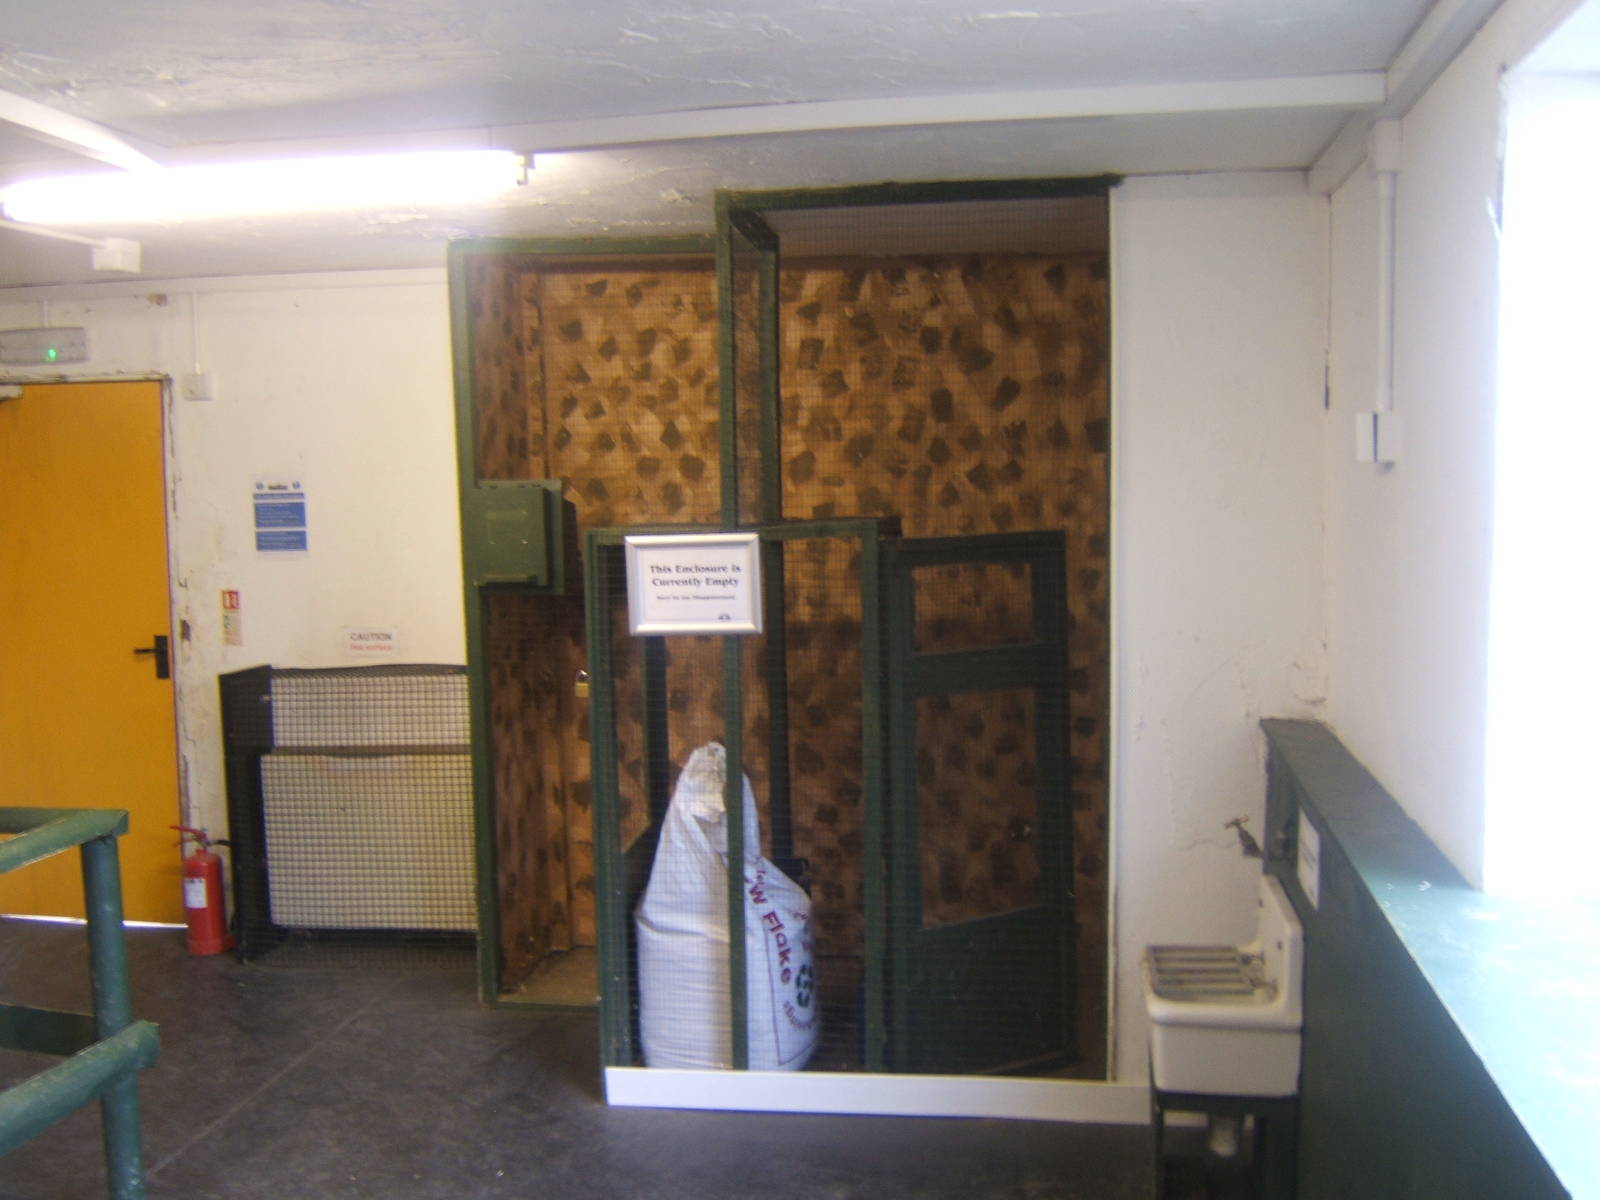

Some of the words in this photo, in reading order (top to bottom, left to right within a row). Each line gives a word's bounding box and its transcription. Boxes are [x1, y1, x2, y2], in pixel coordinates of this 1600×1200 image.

[650, 565, 672, 574] This
[675, 564, 728, 574] Enclosure
[652, 578, 701, 588] Currently
[705, 577, 738, 588] Empty
[350, 631, 392, 641] CAUTION
[762, 910, 792, 985] Flake
